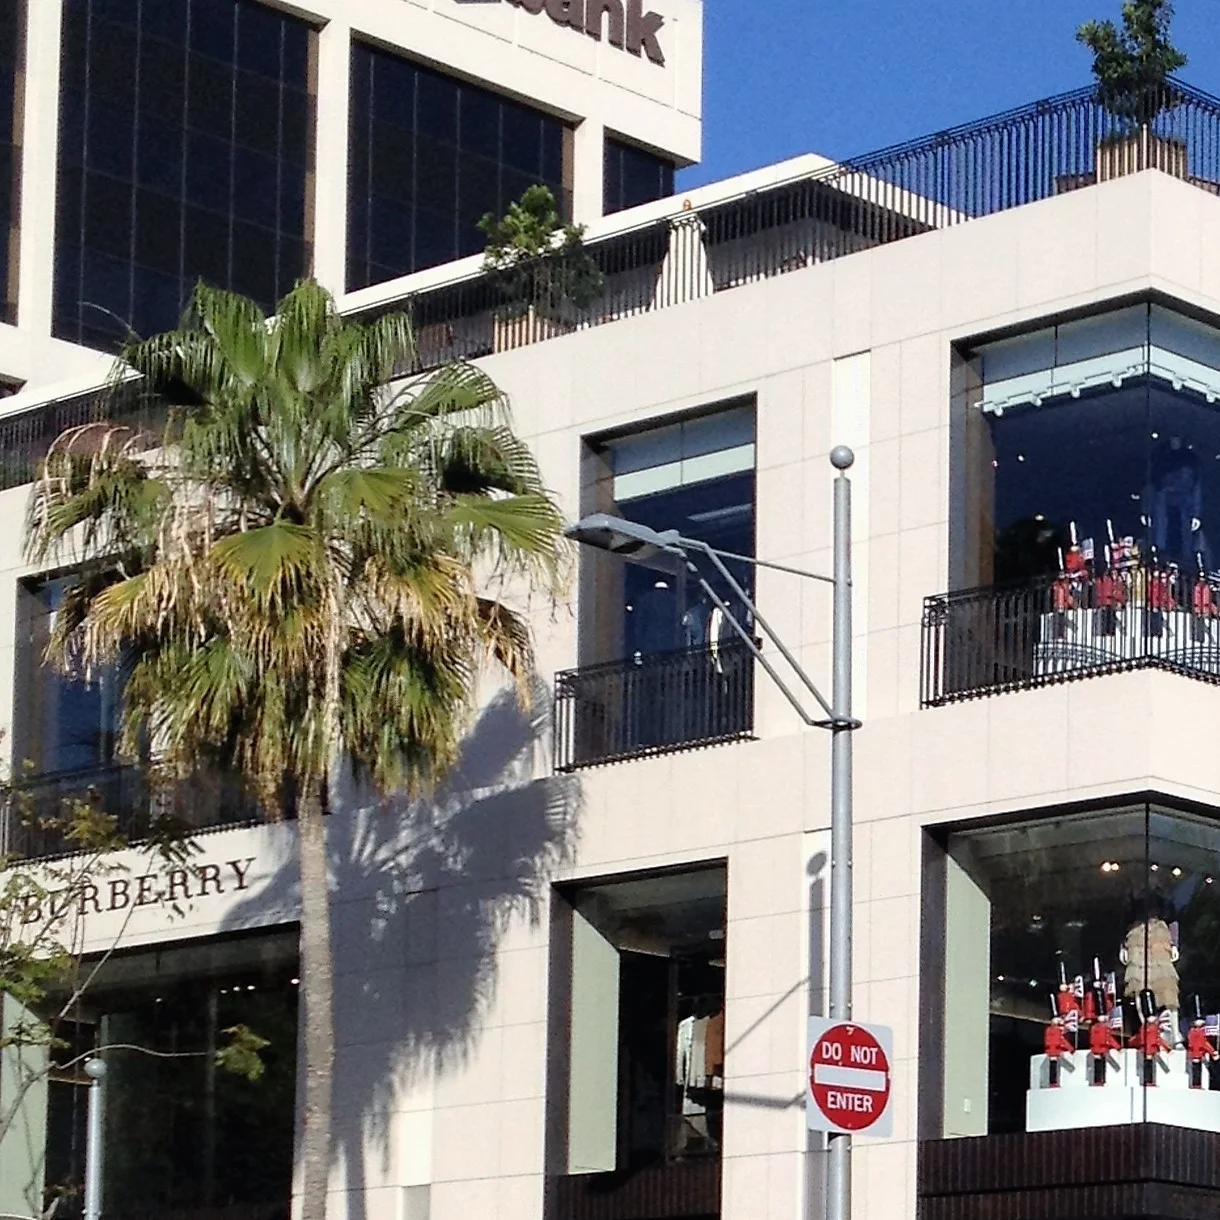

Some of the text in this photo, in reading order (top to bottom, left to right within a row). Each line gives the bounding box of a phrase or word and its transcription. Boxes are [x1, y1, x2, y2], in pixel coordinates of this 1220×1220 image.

[507, 0, 665, 68] ank
[822, 1041, 878, 1065] DO NOT
[827, 1091, 873, 1112] ENTER
